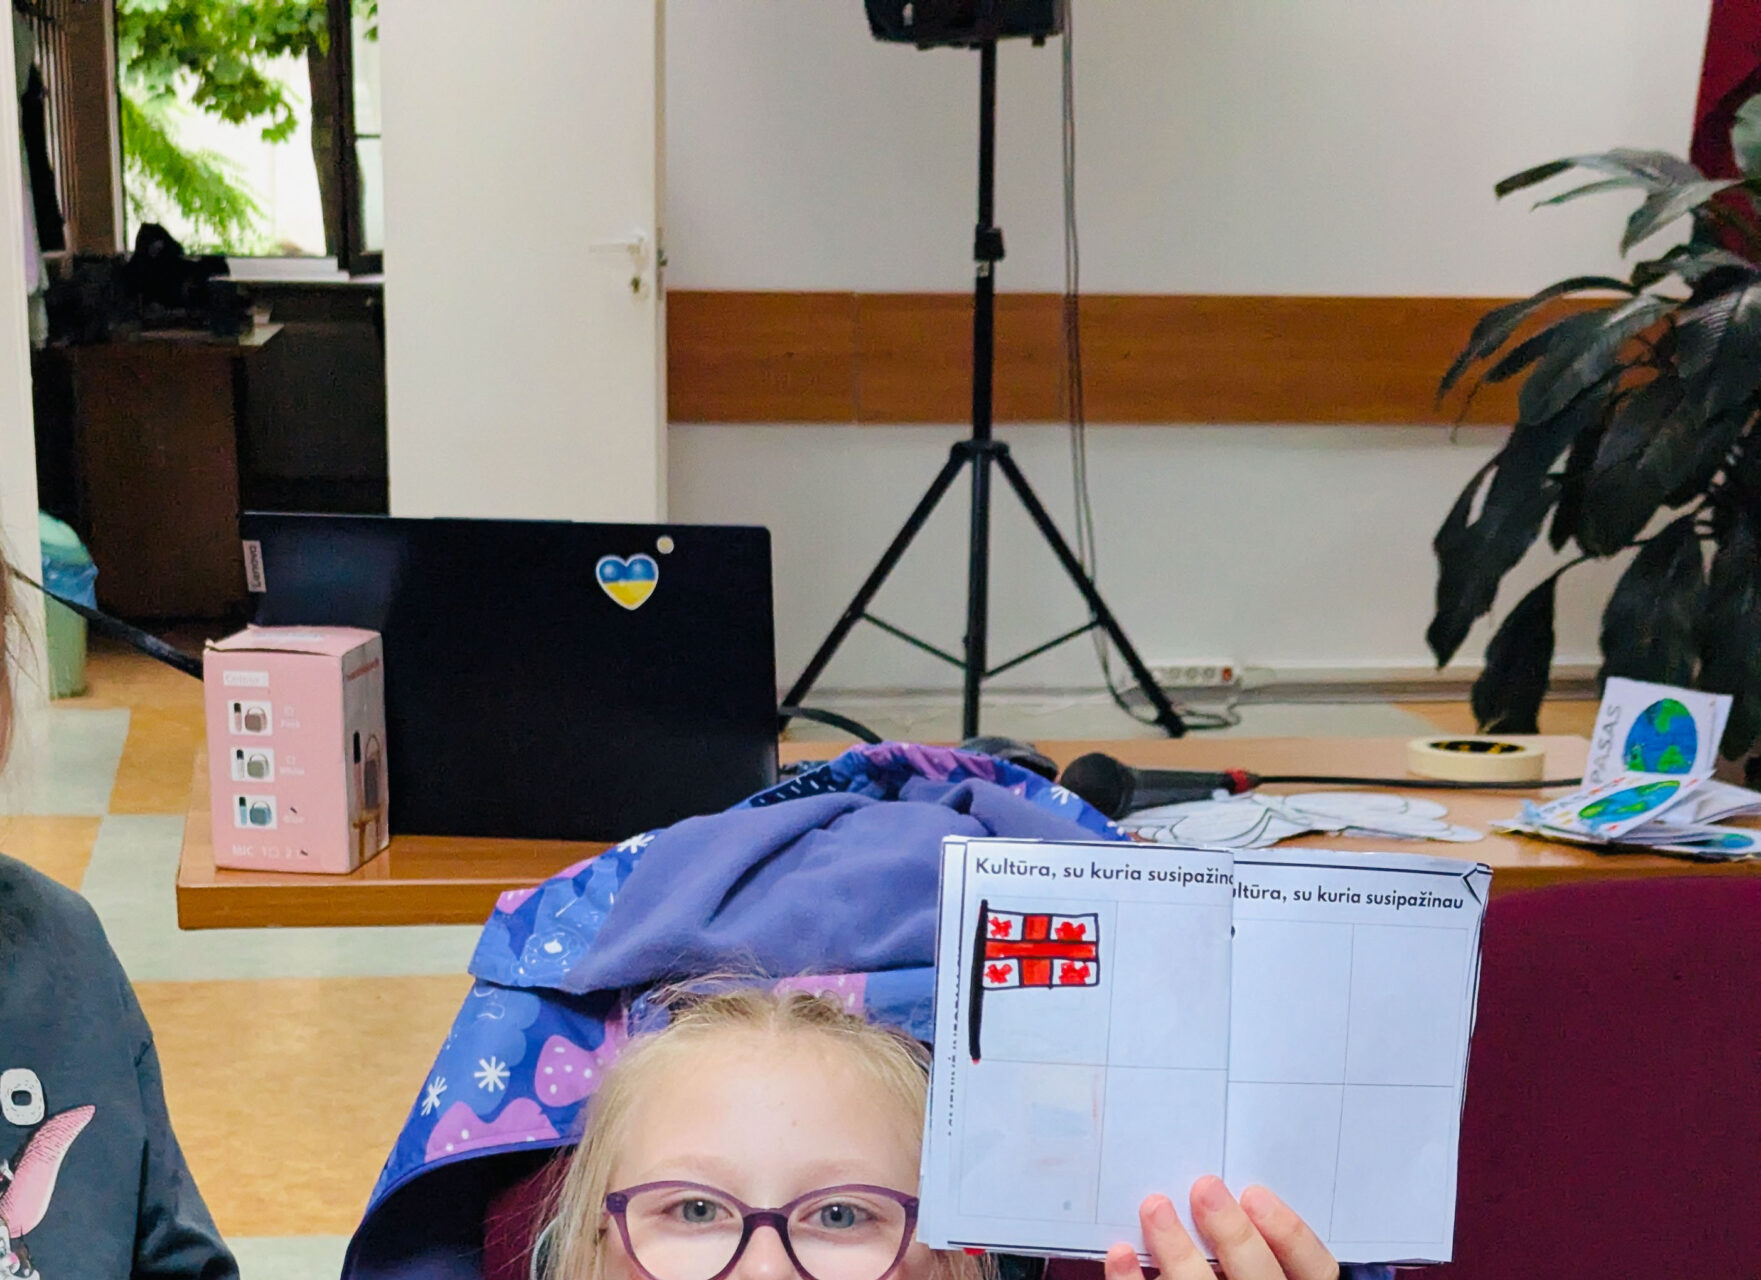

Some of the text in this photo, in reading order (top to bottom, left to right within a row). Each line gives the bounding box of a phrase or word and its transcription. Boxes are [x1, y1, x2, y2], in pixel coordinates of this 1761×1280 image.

[1590, 704, 1622, 784] PASAS
[976, 857, 1056, 880] Kultūra,
[1063, 865, 1084, 878] su
[1090, 861, 1141, 881] kuria
[1293, 890, 1312, 901] su
[1317, 885, 1361, 904] kuria
[1366, 890, 1464, 910] susipažinau
